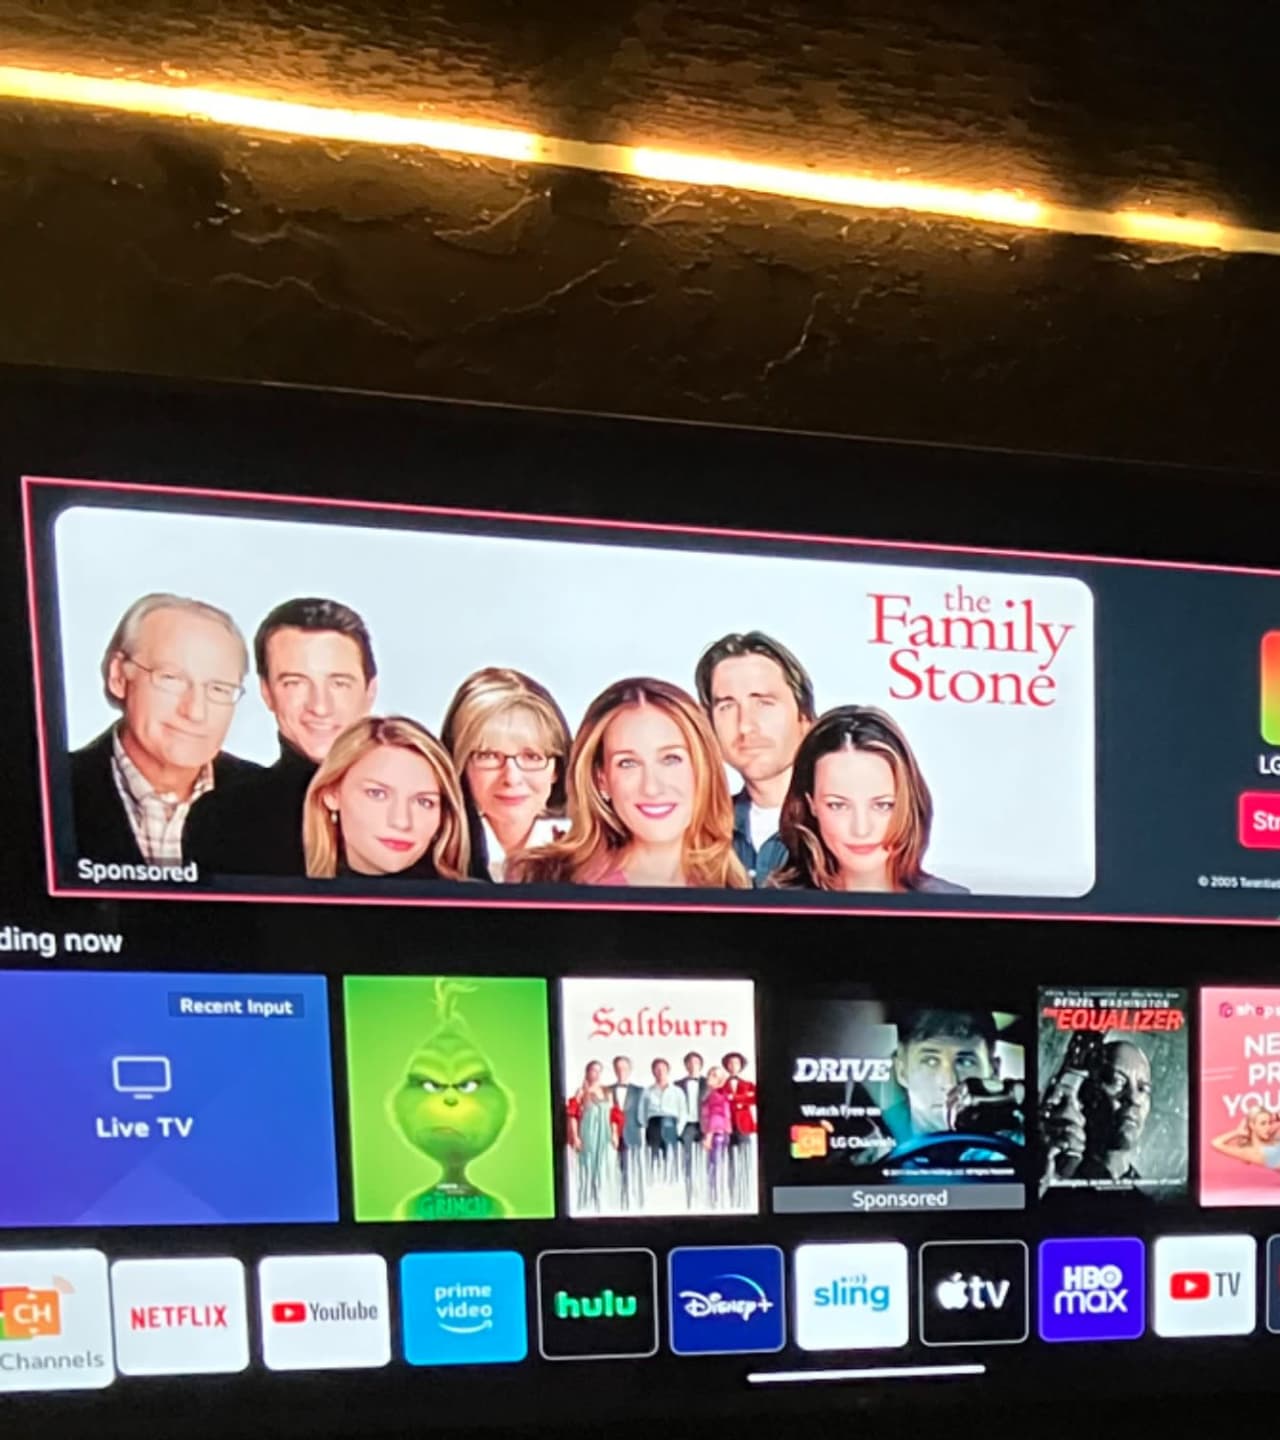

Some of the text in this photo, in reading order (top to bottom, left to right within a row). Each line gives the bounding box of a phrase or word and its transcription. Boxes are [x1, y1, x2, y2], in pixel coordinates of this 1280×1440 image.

[945, 584, 991, 613] the
[867, 592, 1076, 671] Family
[889, 648, 1056, 707] Stone
[78, 858, 198, 884] Sponsored
[1211, 876, 1238, 888] 2005
[64, 933, 123, 953] now
[180, 997, 294, 1016] Recent Input
[588, 1006, 728, 1040] Saltburn
[1056, 1008, 1184, 1031] EQUALIZER
[792, 1057, 893, 1083] DRIVE
[801, 1105, 838, 1117] Watch
[96, 1117, 194, 1139] Live TV
[830, 1136, 846, 1148] LG
[852, 1189, 948, 1210] Sponsored
[1063, 1264, 1123, 1290] HBO
[1215, 1272, 1241, 1297] TV
[435, 1283, 491, 1301] prime
[814, 1277, 890, 1312] sling
[970, 1275, 1010, 1308] tv
[1054, 1289, 1128, 1314] max
[13, 1304, 51, 1324] CH
[309, 1301, 378, 1321] YouTube
[437, 1301, 492, 1319] video
[556, 1291, 637, 1318] hulu
[131, 1305, 228, 1330] NETFLIX
[0, 1350, 104, 1371] Channels
